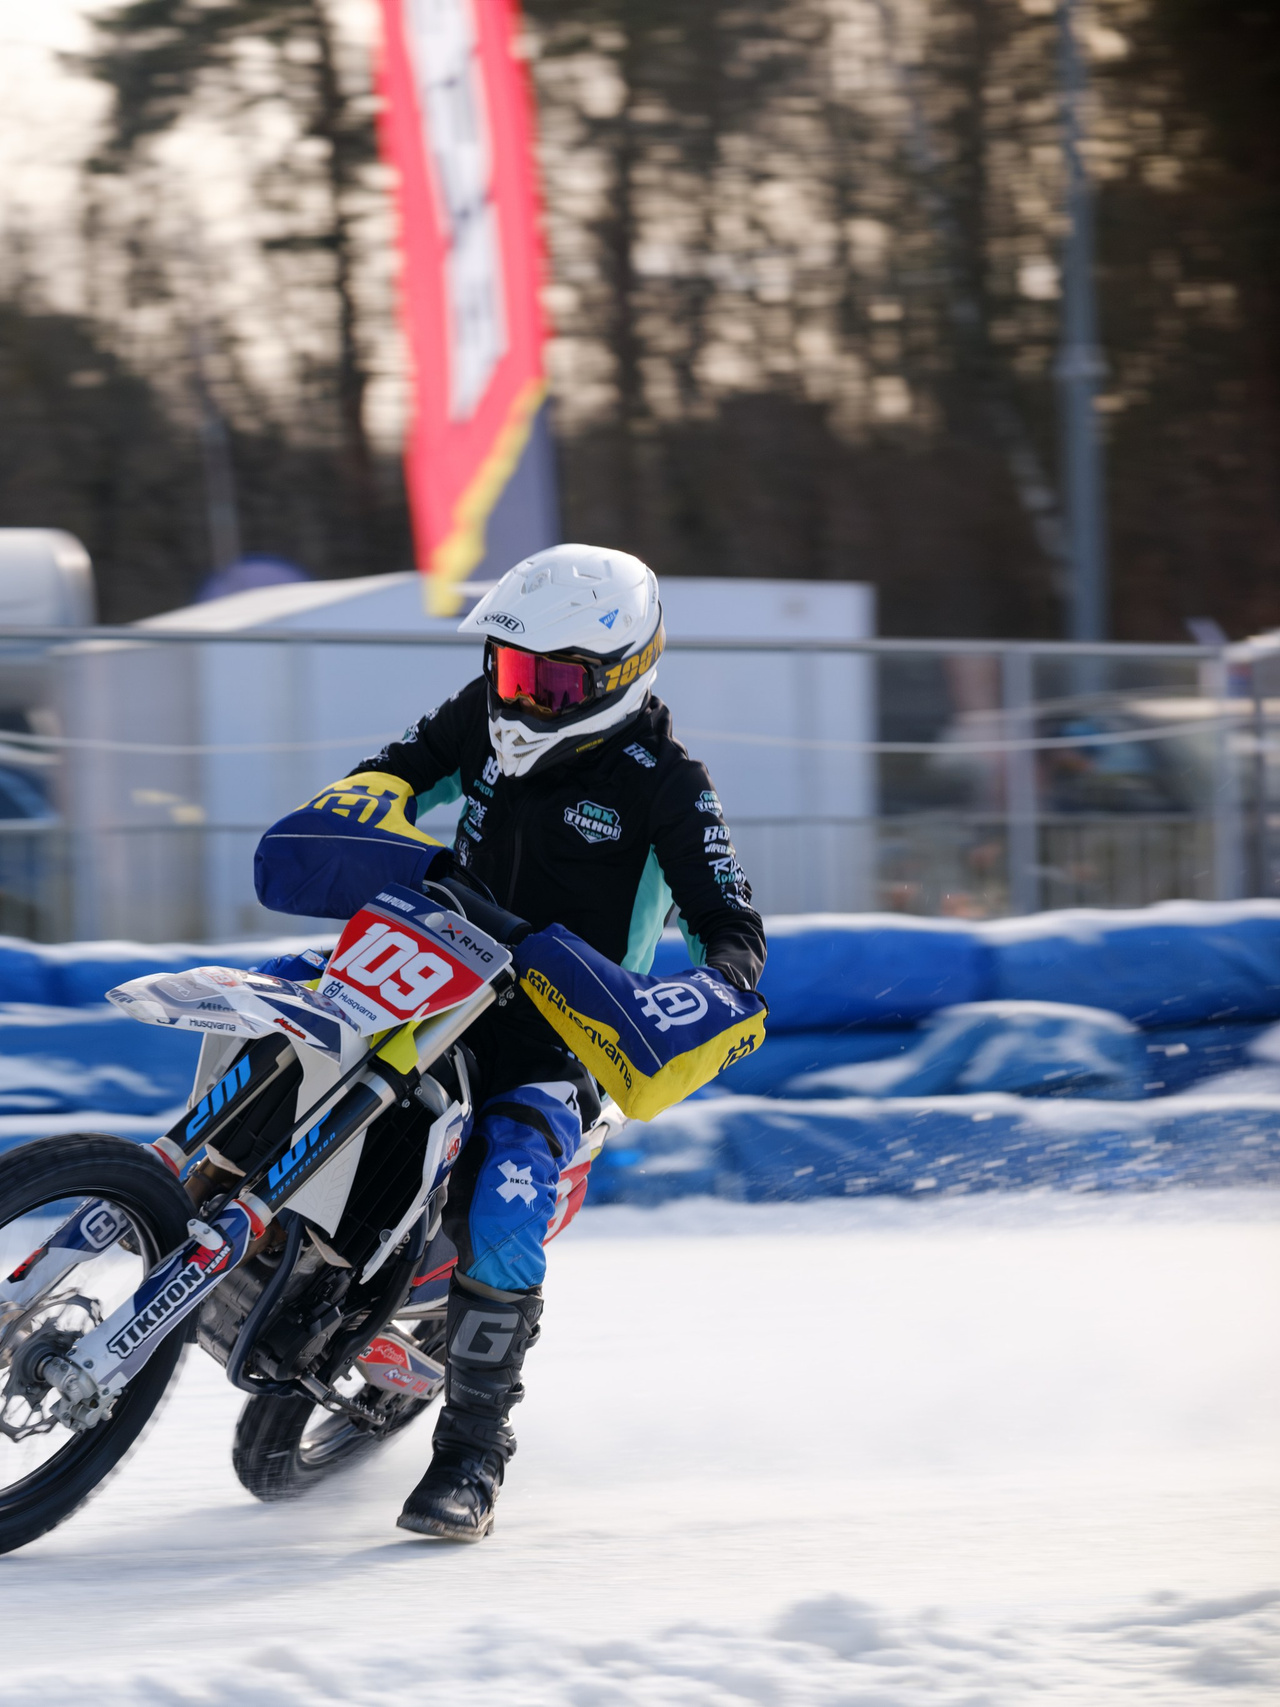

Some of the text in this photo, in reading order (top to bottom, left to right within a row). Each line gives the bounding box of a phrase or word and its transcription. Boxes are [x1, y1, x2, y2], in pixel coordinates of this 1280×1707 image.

[483, 613, 520, 632] SHOEI
[605, 632, 664, 692] 100%
[582, 804, 614, 825] MX
[459, 936, 494, 963] RMG
[330, 922, 454, 1011] 109
[338, 992, 378, 1022] Husqvarna
[188, 1018, 237, 1032] Husqvarna
[547, 986, 633, 1091] Husqvarna
[204, 1245, 231, 1275] TEAM
[109, 1263, 204, 1357] TIKHON
